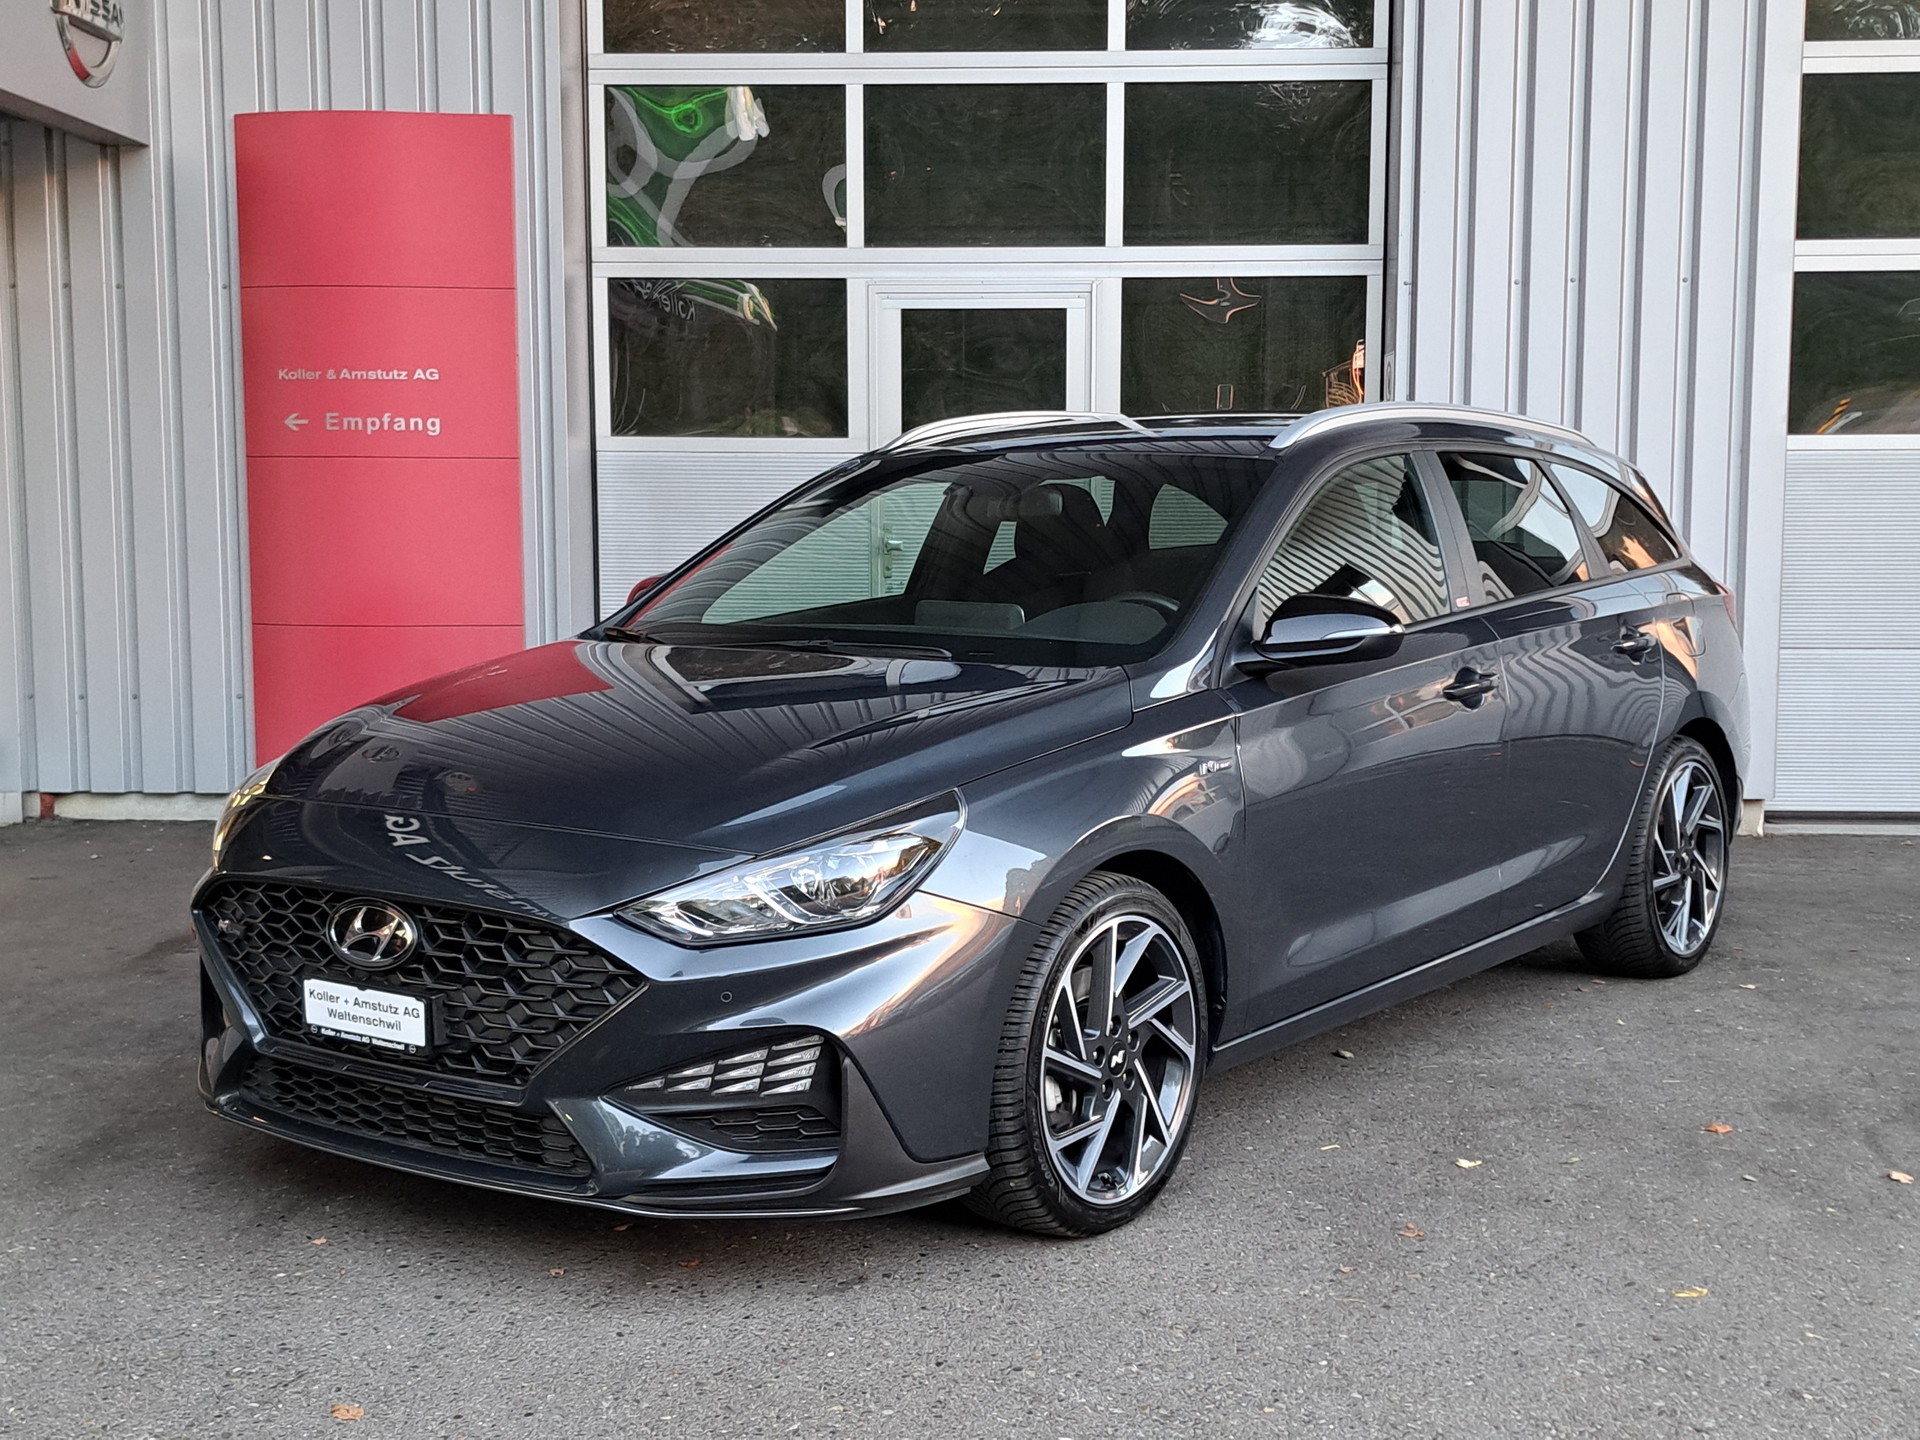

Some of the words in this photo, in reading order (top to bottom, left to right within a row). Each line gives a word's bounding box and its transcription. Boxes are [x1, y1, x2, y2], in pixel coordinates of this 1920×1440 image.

[278, 369, 321, 380] Koller
[326, 369, 337, 380] &
[339, 368, 408, 380] Amstutz
[413, 368, 440, 380] AG
[325, 412, 441, 436] Empfang
[309, 988, 340, 1004] Koller
[353, 997, 400, 1015] Amstutz
[403, 1006, 421, 1019] AG
[327, 1007, 402, 1031] Waltenschwil
